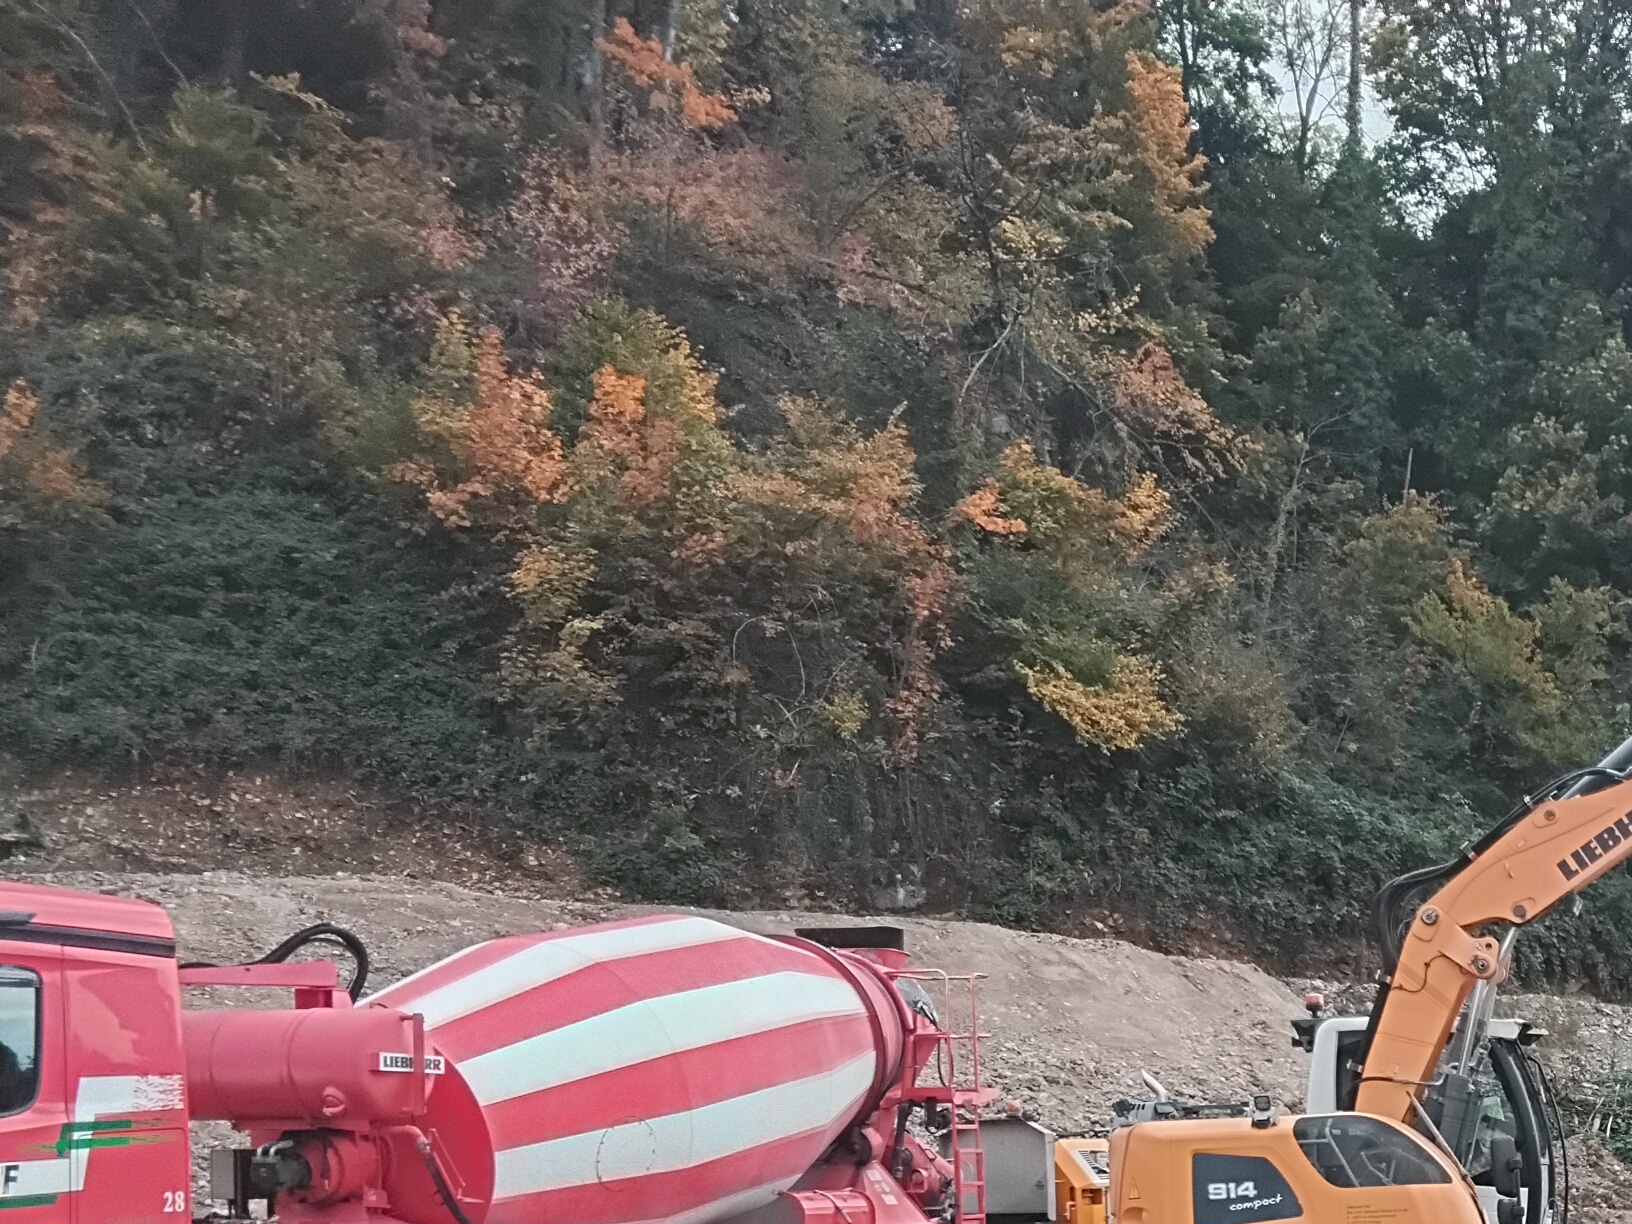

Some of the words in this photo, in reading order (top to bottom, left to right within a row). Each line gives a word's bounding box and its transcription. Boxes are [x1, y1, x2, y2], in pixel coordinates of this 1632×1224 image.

[1207, 1181, 1258, 1200] 914
[163, 1190, 185, 1213] 28
[1229, 1193, 1283, 1211] compact
